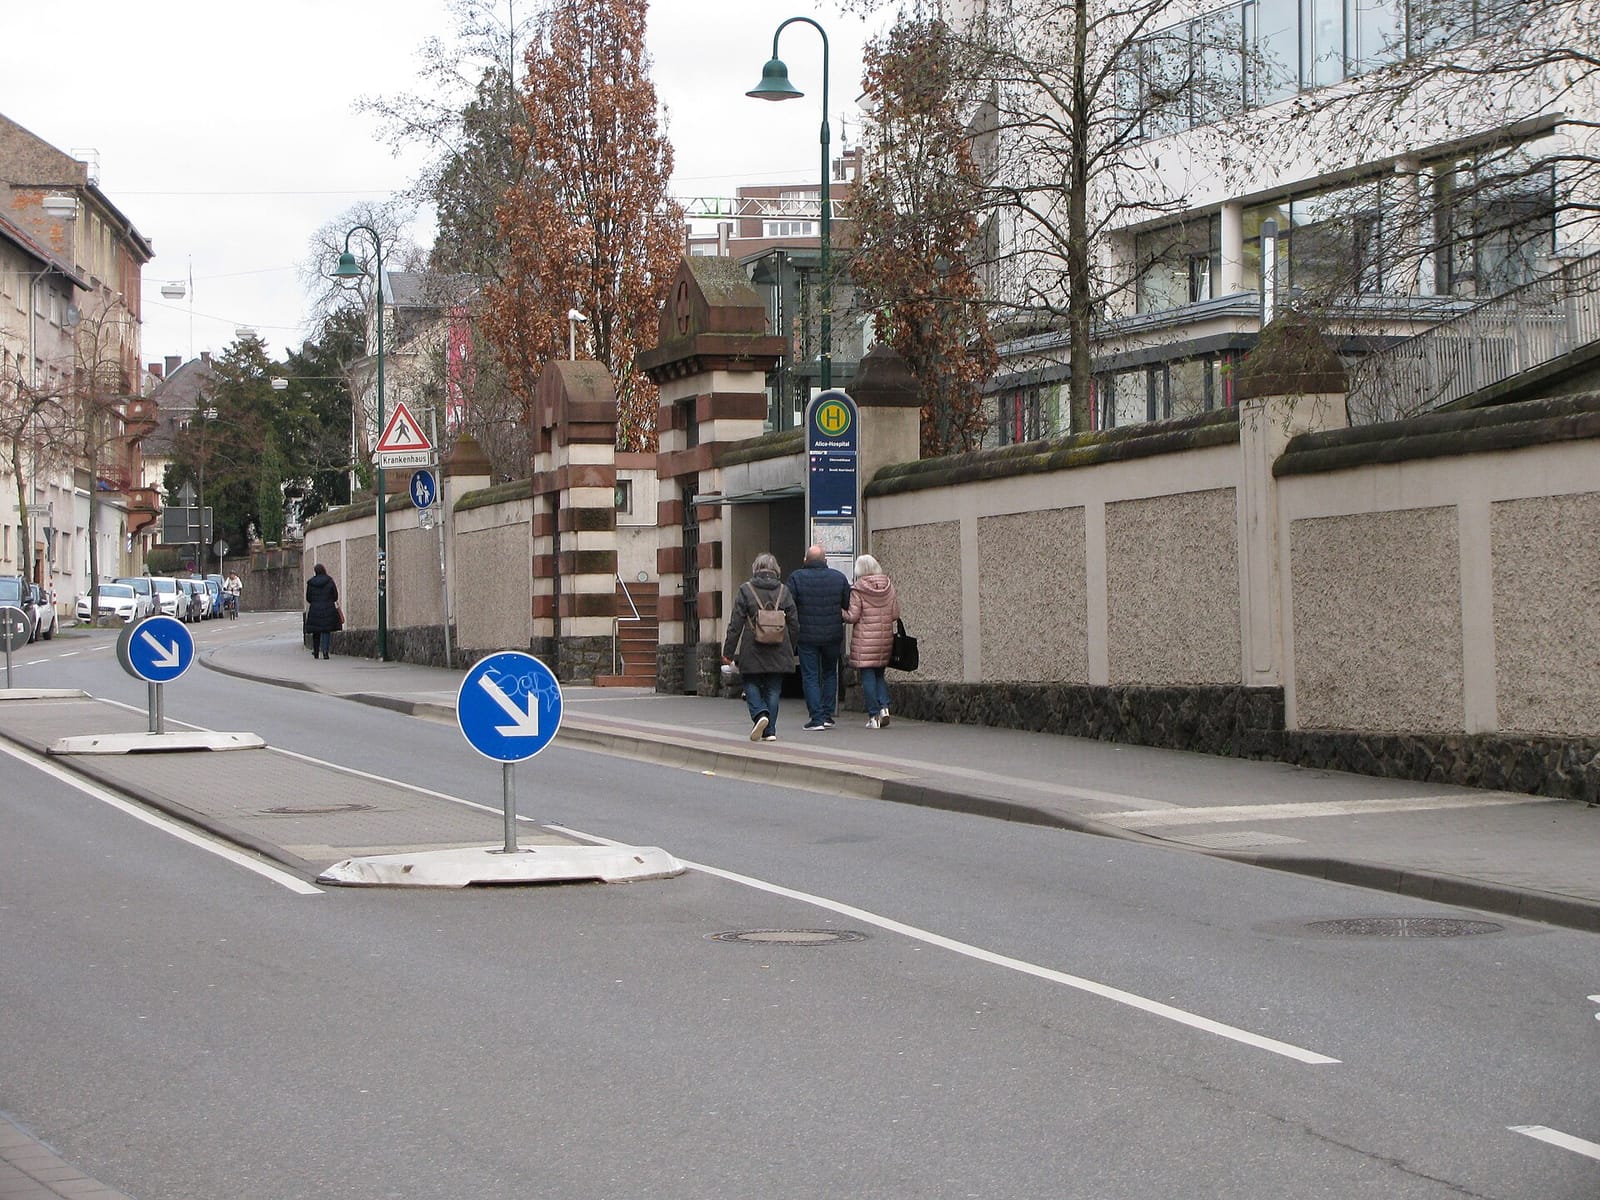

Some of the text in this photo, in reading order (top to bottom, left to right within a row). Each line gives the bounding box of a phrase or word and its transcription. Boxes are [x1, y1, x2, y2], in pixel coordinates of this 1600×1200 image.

[827, 408, 840, 428] H
[815, 440, 850, 448] Alice-Hospital
[383, 455, 426, 465] Krankenhaus
